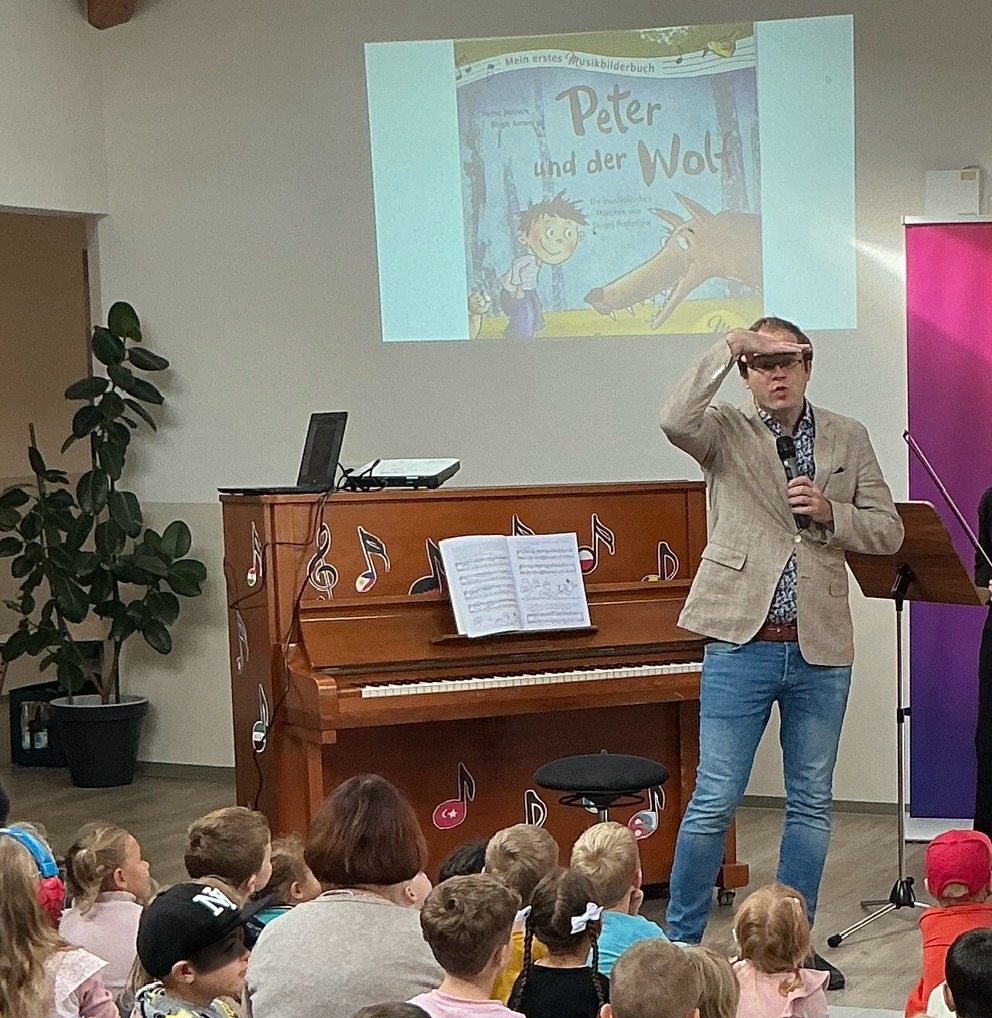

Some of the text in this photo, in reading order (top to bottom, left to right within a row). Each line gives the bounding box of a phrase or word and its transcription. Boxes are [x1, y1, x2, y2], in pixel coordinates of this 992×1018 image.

[505, 51, 655, 73] Mein erstes Musikbilderbuch
[556, 83, 661, 137] Peter
[534, 131, 733, 188] und der Wolf
